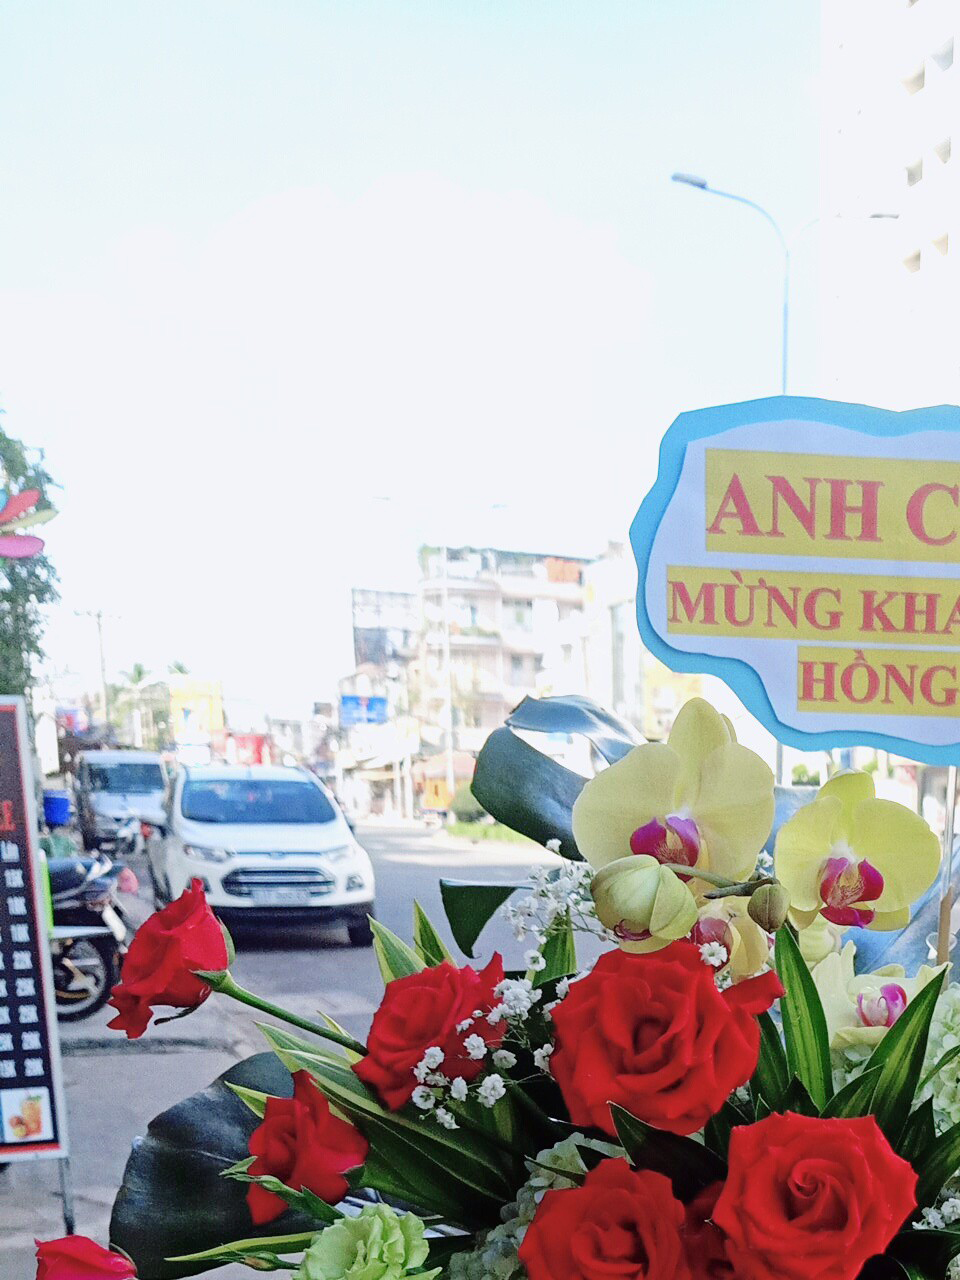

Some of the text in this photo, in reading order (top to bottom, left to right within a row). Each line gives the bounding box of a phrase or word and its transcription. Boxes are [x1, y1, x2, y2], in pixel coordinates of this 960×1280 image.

[706, 471, 885, 542] ANH
[668, 569, 844, 631] MỪNG
[797, 648, 960, 708] HỒNG
